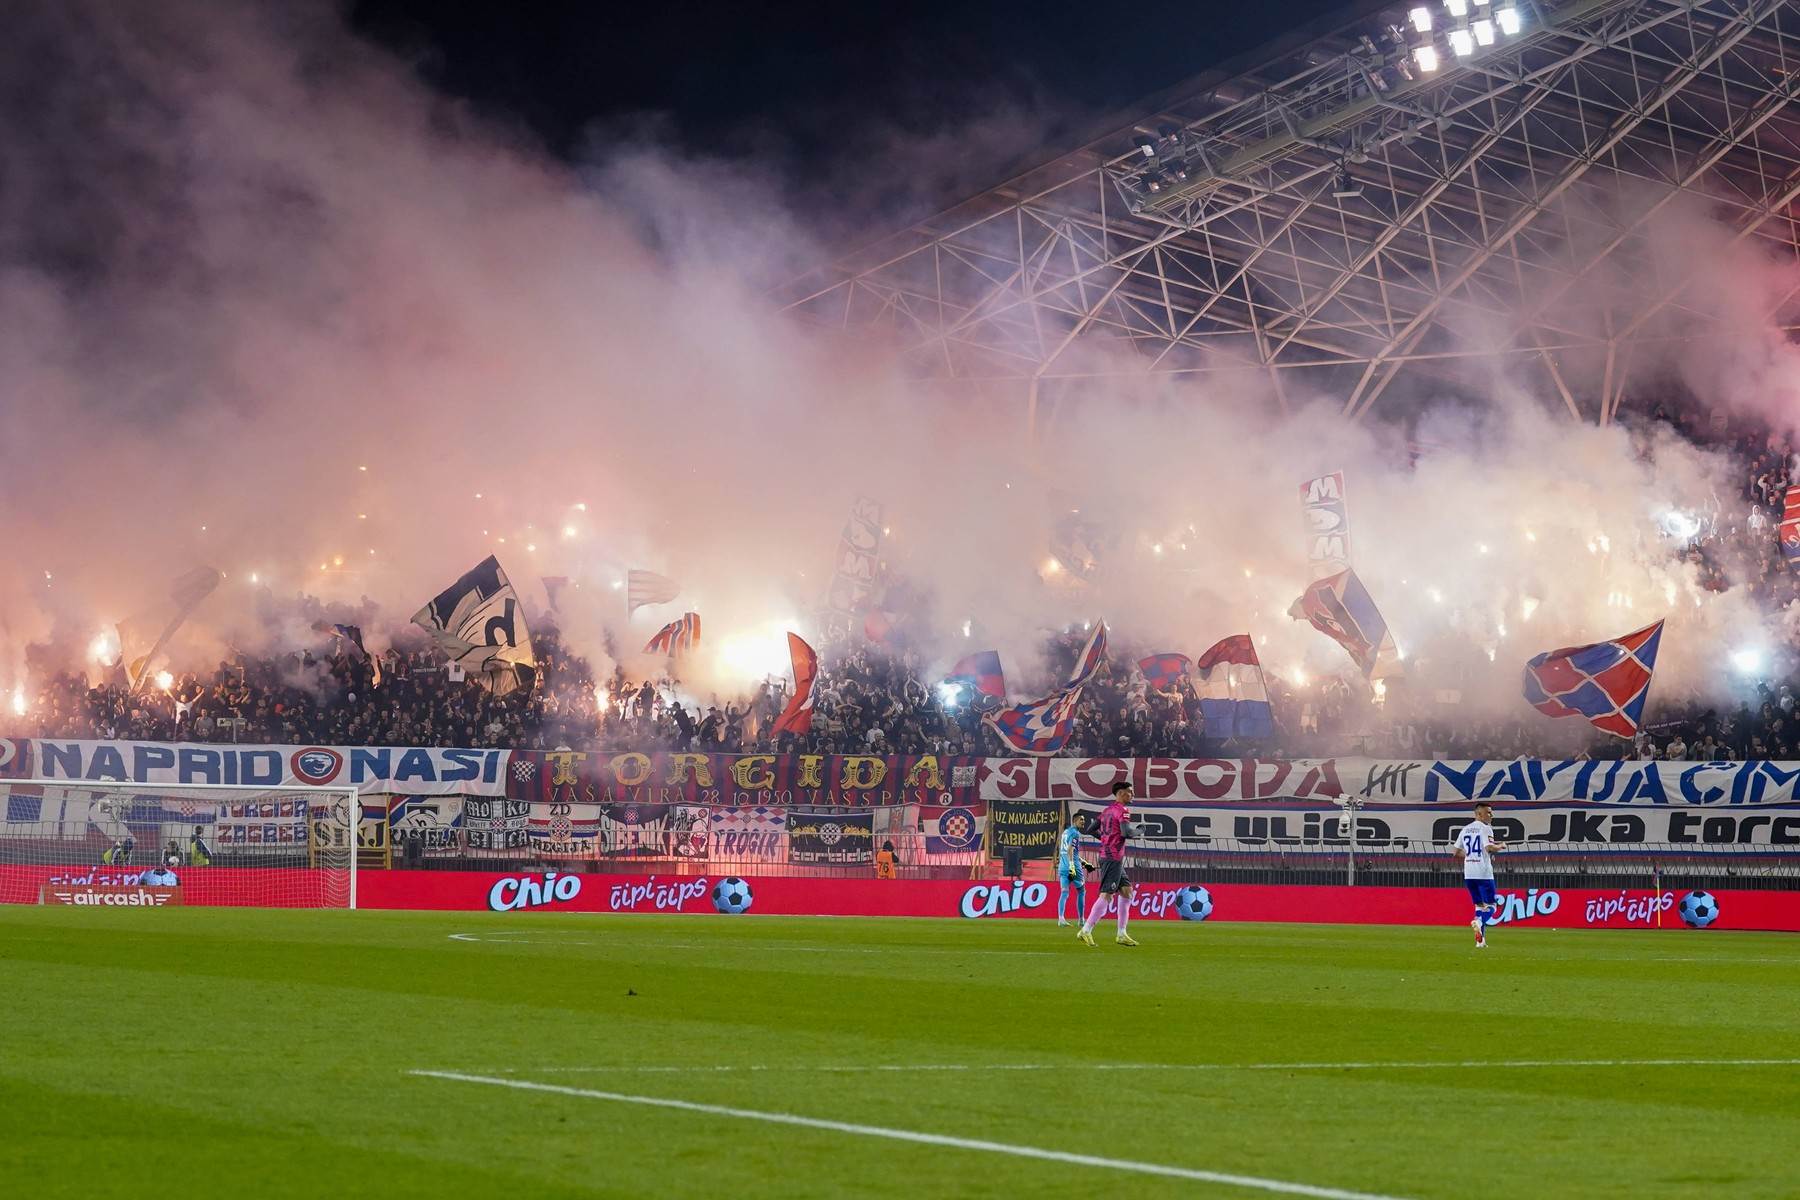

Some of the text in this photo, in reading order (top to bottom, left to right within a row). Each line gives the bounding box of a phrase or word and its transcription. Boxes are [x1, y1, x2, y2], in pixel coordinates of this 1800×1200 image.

[40, 741, 282, 786] NAPRID
[545, 752, 945, 791] TORCIDA
[996, 756, 1345, 799] SLOBODA
[549, 803, 571, 817] ZD
[995, 811, 1007, 824] UZ
[600, 808, 668, 856] ŠIBENIK
[714, 828, 779, 857] TROGIR
[1464, 835, 1482, 857] 34
[73, 888, 158, 906] aircash
[489, 872, 581, 912] Chio
[961, 880, 1047, 918] Chio
